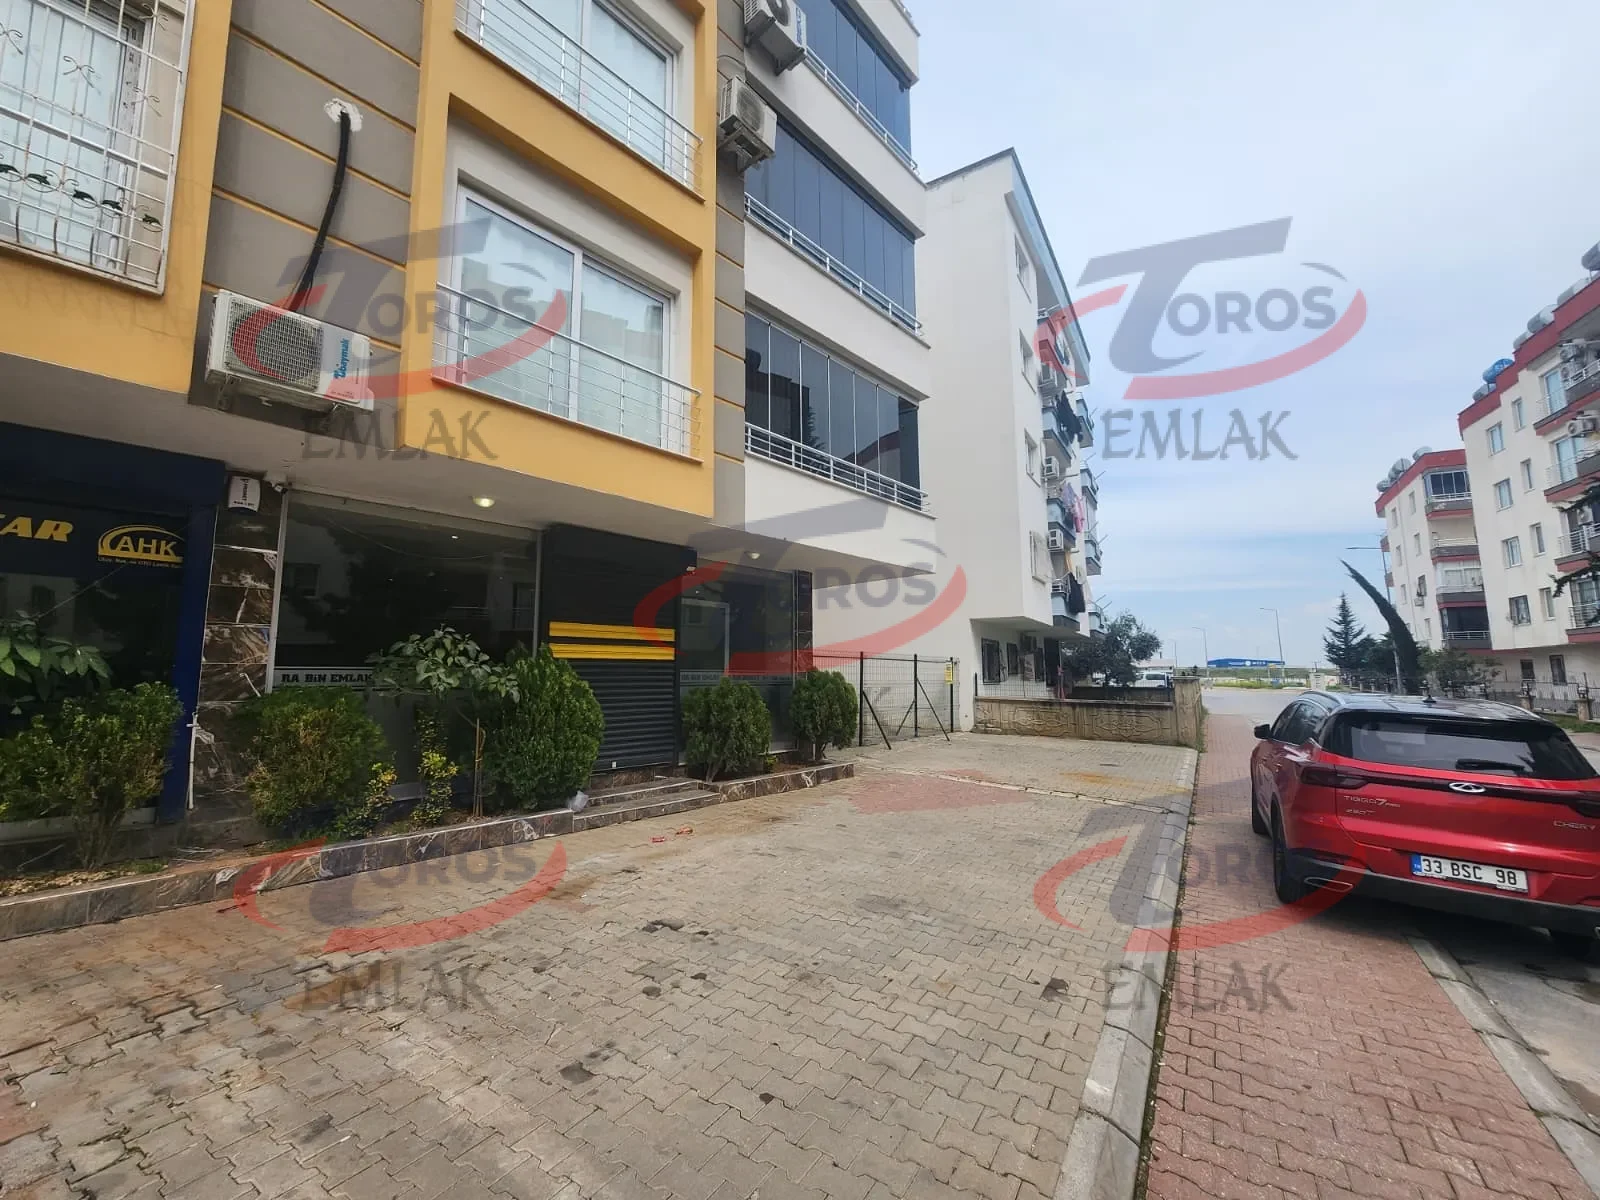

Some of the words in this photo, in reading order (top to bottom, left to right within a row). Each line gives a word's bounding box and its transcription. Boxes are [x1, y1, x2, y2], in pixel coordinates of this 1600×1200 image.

[0, 514, 74, 542] AR
[116, 535, 177, 558] AHK
[330, 673, 373, 683] EMLAK
[1422, 857, 1443, 874] 33
[1451, 862, 1483, 881] BSC
[1495, 869, 1517, 886] 98
